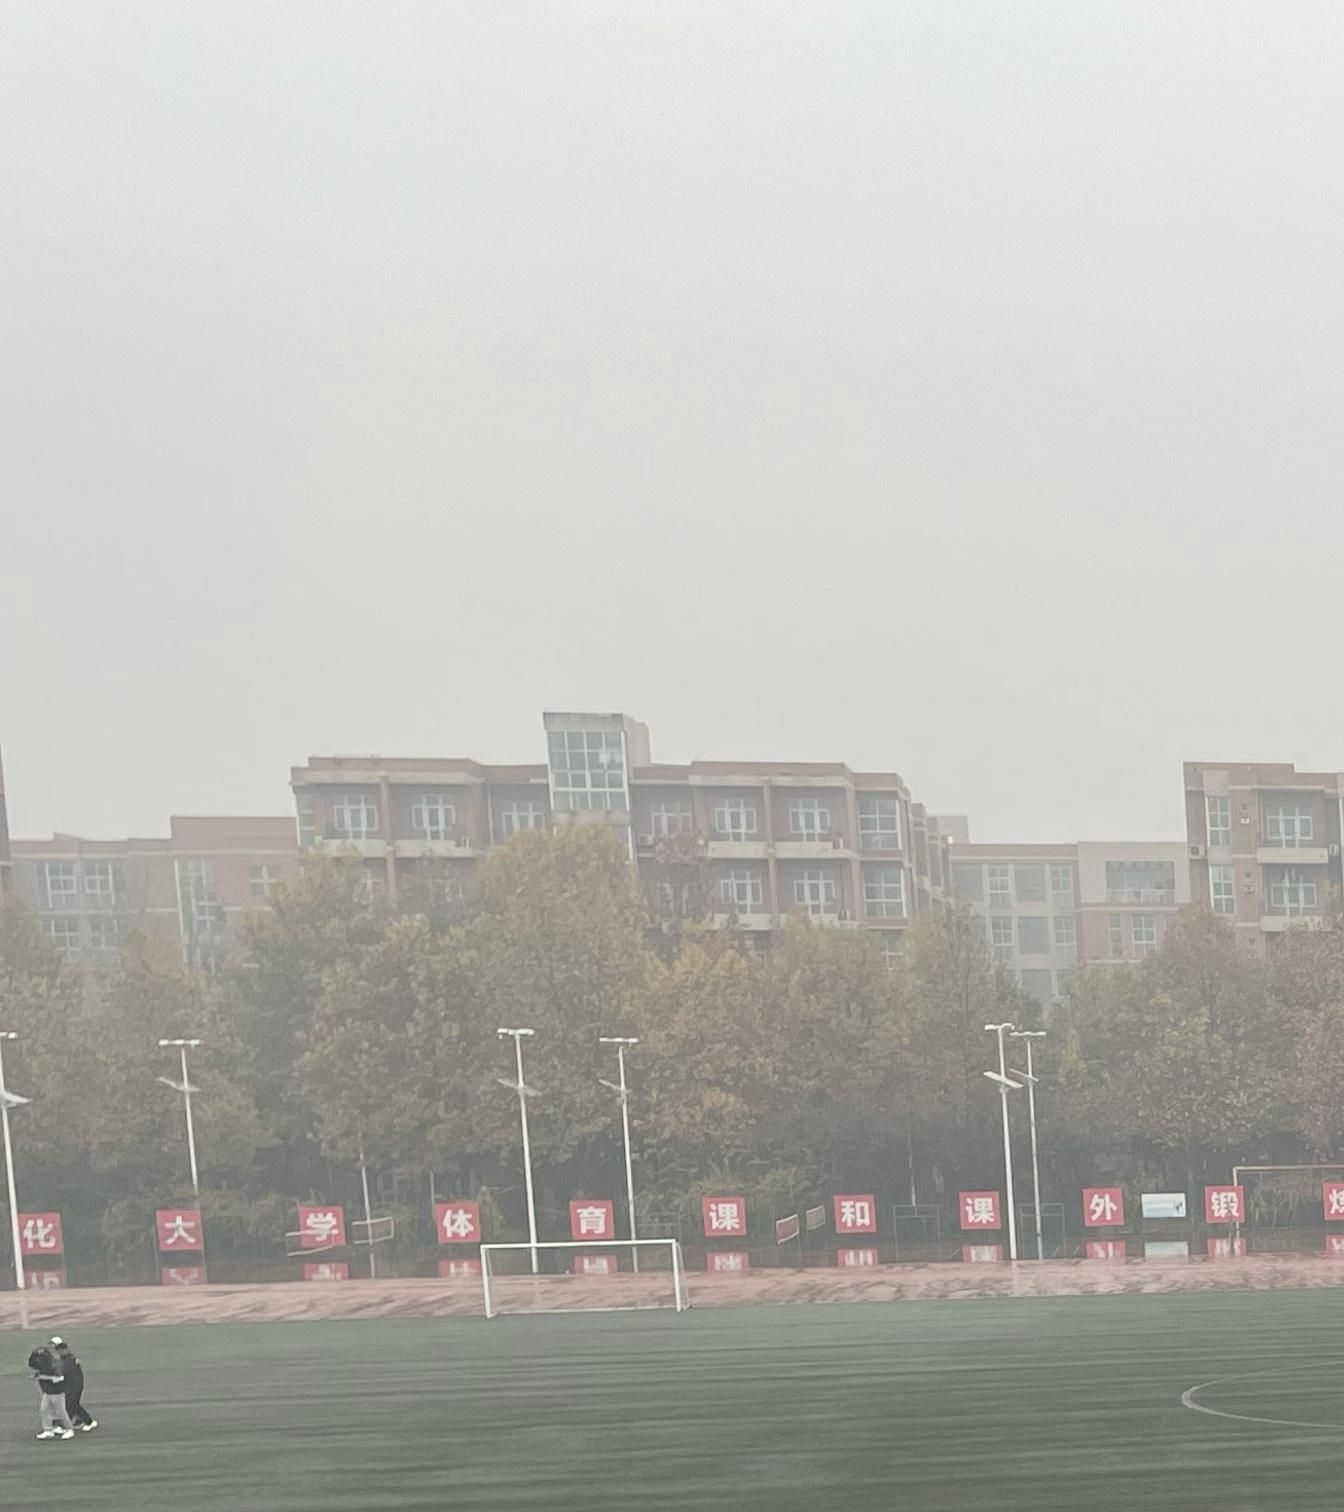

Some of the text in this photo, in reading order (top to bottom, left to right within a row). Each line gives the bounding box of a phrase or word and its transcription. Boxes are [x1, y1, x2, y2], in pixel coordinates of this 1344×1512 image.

[709, 1202, 740, 1231] 课
[840, 1200, 871, 1228] 和
[965, 1196, 996, 1225] 课
[1089, 1193, 1118, 1221] 外
[1210, 1190, 1240, 1219] 锻
[23, 1218, 56, 1249] 化
[164, 1215, 196, 1245] 大
[306, 1212, 339, 1241] 学
[442, 1208, 475, 1238] 体
[576, 1205, 608, 1234] 育
